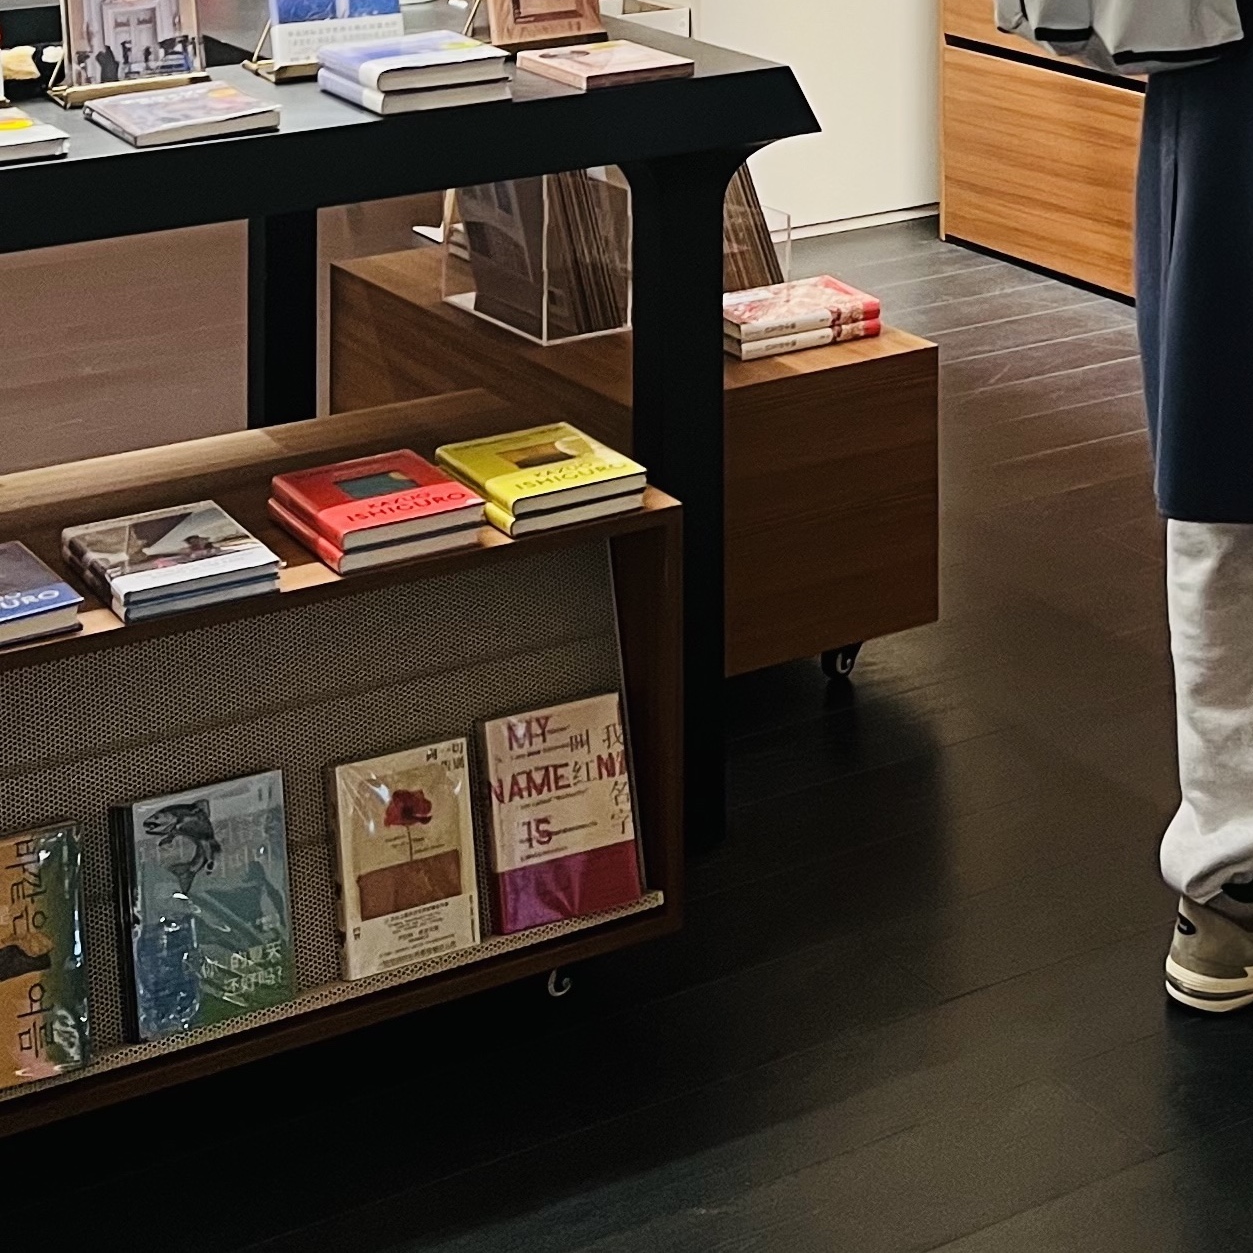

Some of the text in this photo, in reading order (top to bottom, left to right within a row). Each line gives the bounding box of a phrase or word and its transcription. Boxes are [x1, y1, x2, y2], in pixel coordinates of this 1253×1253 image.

[346, 492, 466, 522] ISHIGURO
[507, 715, 551, 752] MY
[490, 763, 571, 804] NAME
